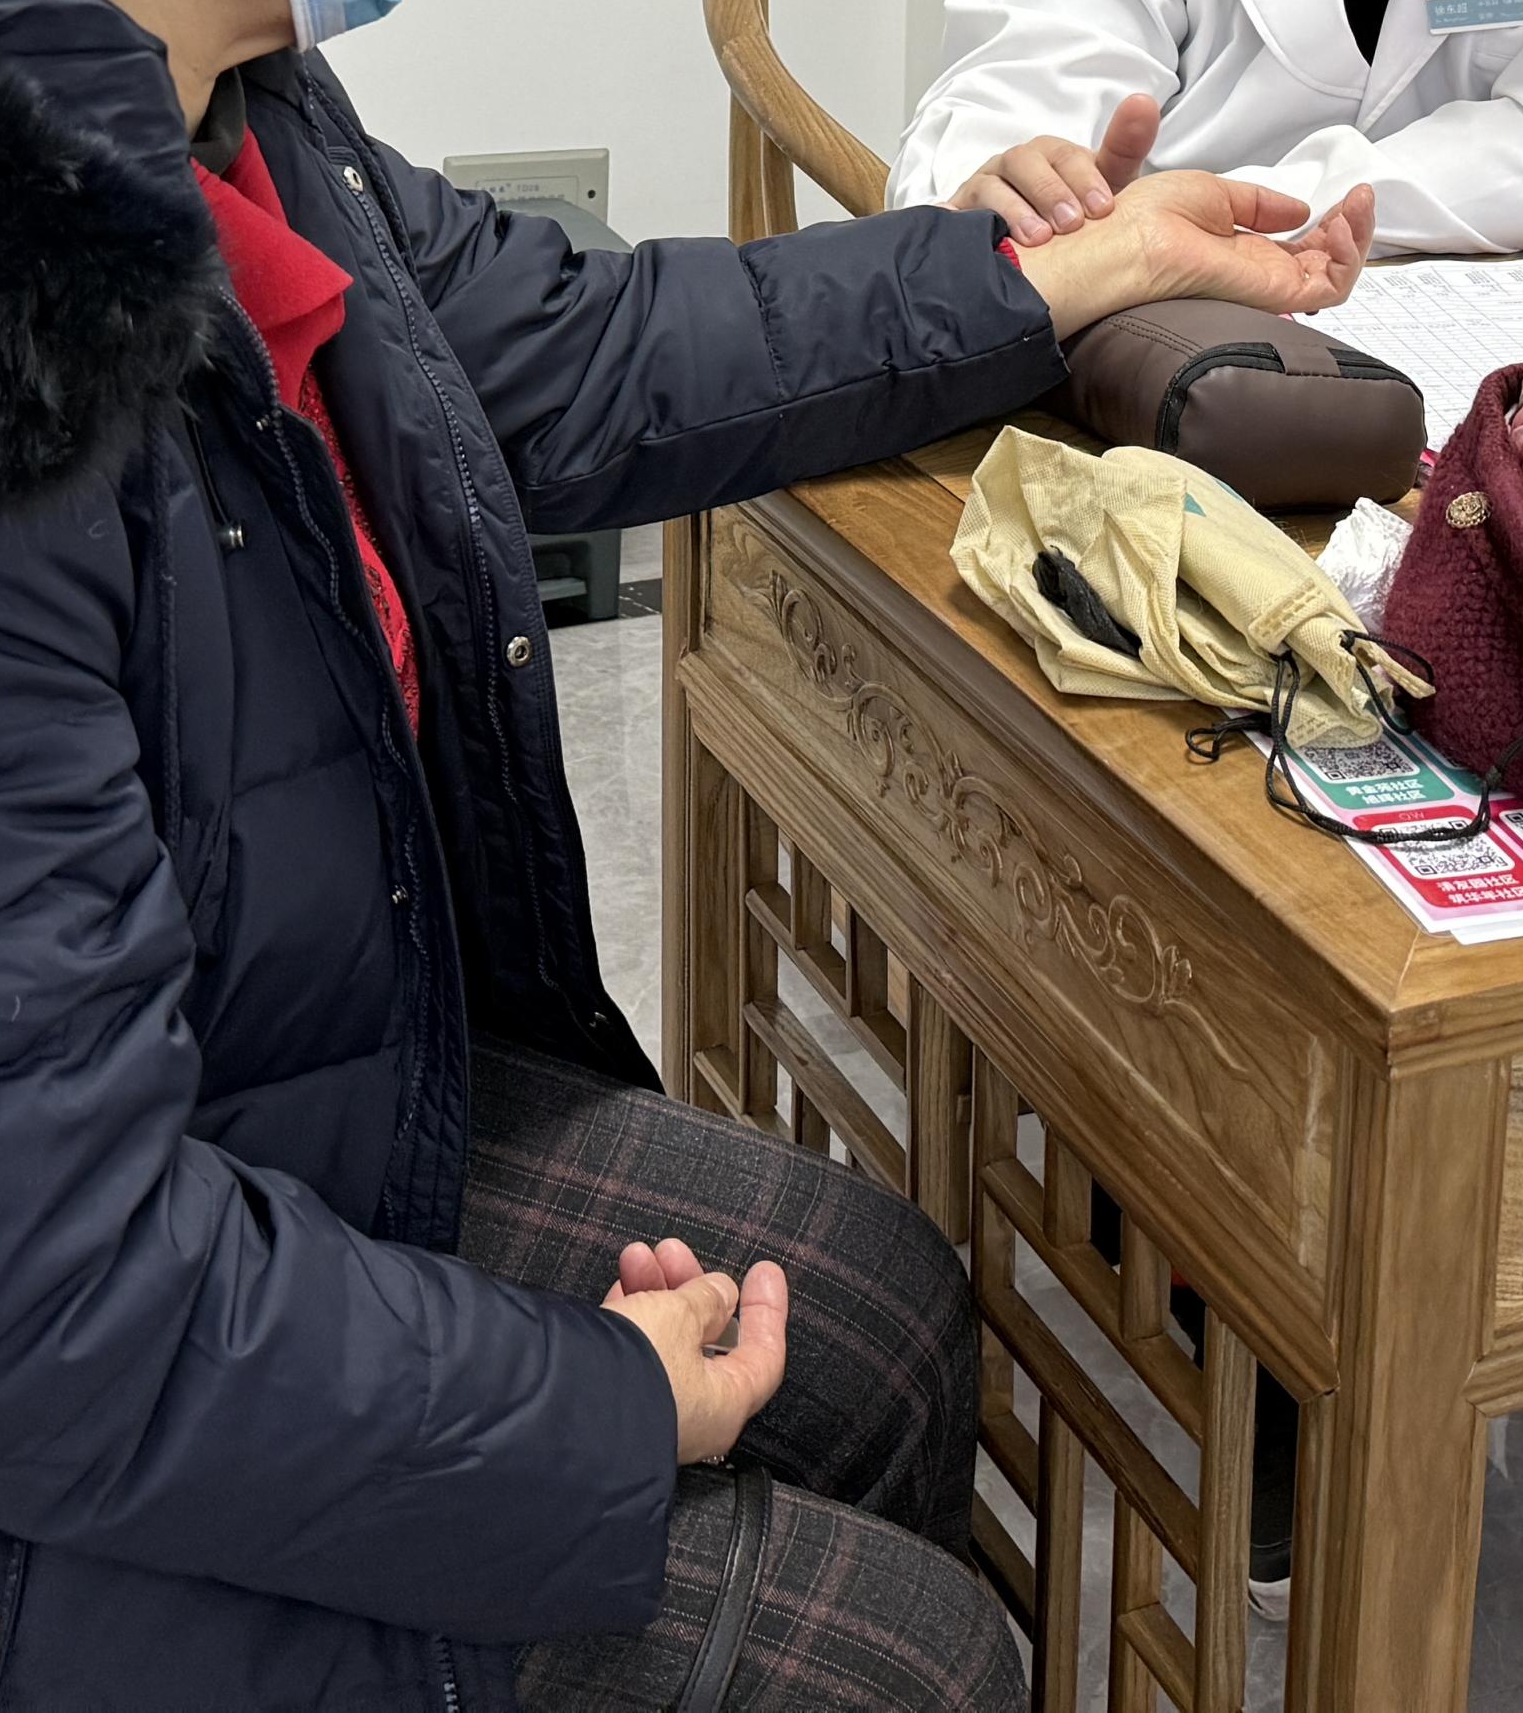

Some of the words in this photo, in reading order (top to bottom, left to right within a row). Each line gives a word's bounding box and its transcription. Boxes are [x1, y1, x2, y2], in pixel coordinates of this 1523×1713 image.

[1345, 779, 1424, 796] 黄金苑社区
